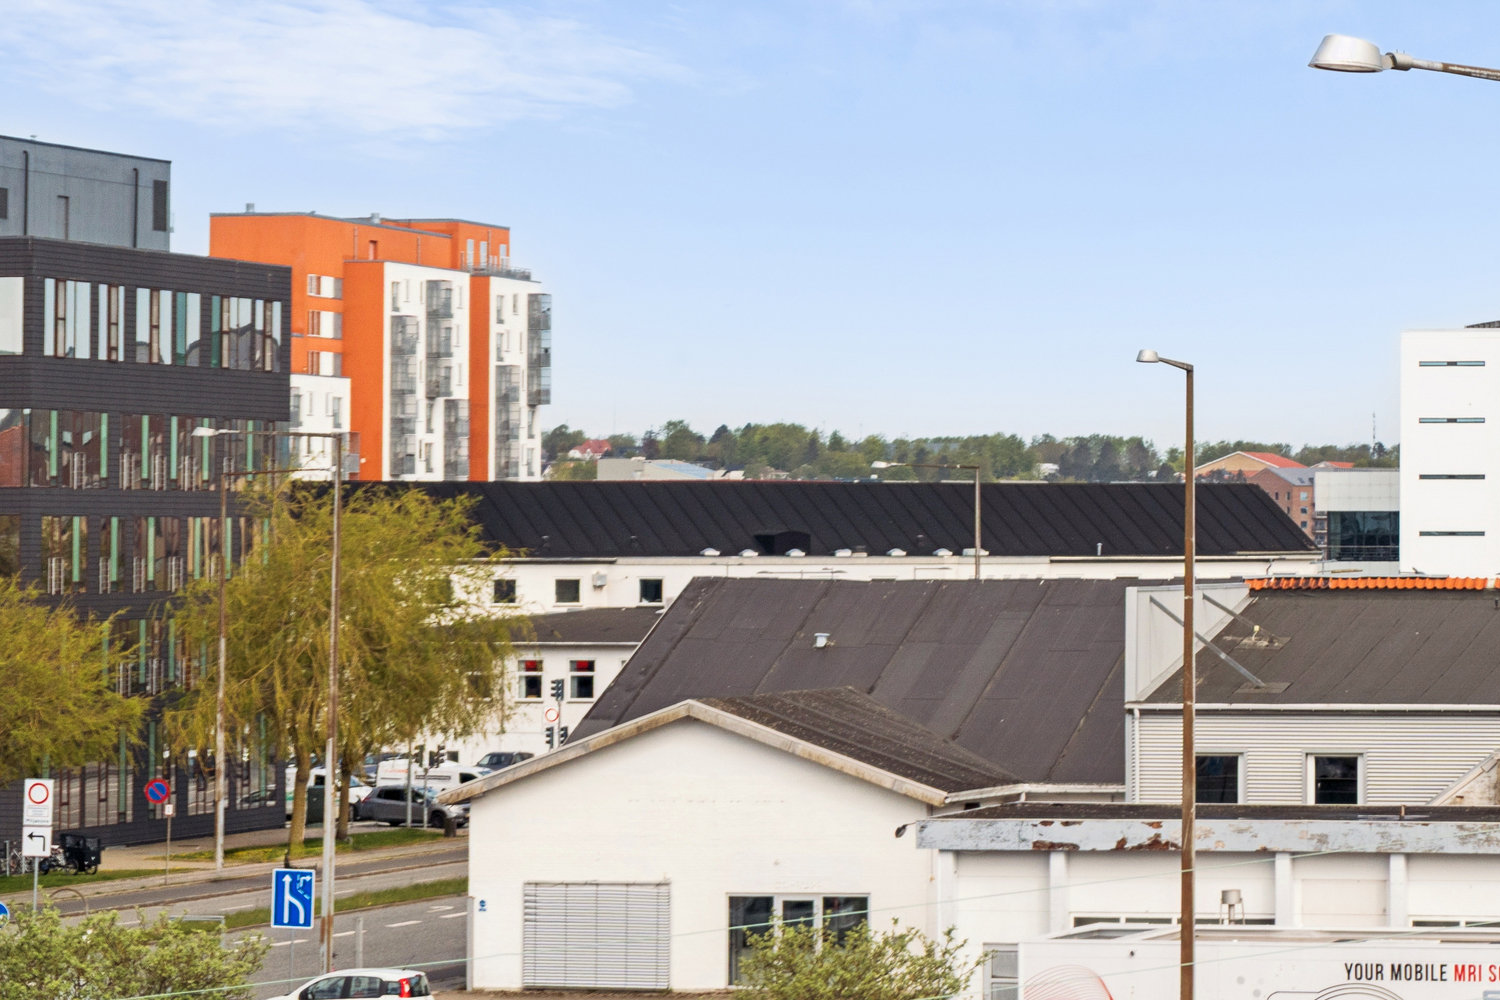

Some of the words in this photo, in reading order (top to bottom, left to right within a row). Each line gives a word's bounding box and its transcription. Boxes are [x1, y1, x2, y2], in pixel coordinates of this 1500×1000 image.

[1344, 962, 1384, 981] YOUR
[1390, 963, 1448, 982] MOBILE
[1453, 964, 1482, 982] MRI
